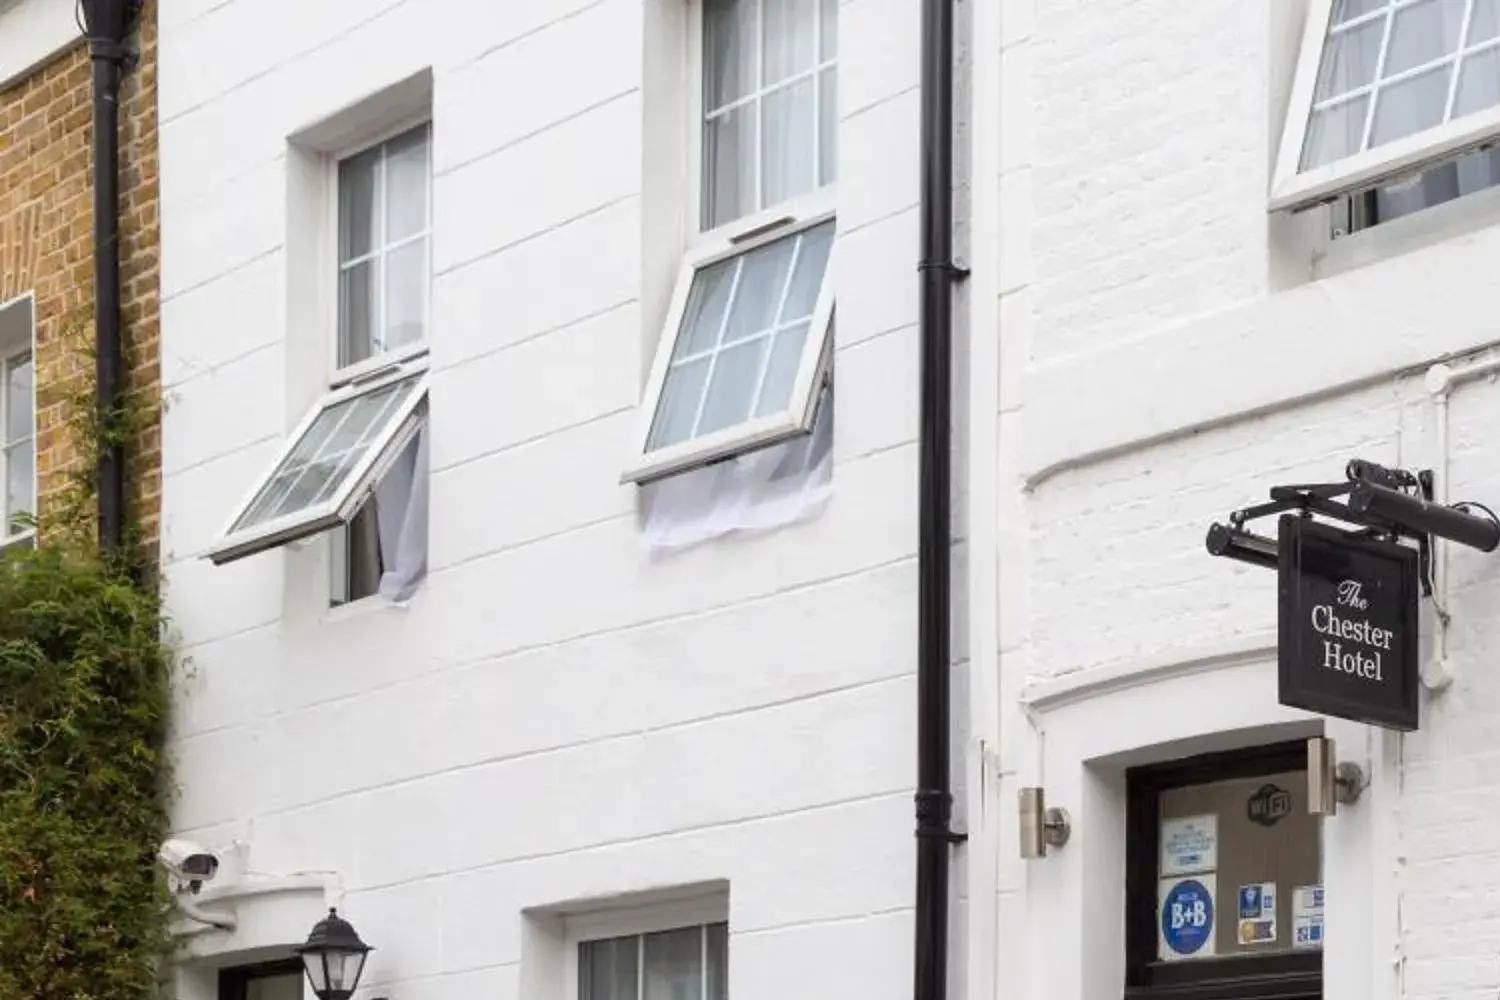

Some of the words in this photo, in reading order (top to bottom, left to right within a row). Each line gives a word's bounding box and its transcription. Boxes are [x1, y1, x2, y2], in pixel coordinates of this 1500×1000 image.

[1337, 579, 1368, 610] The
[1311, 605, 1393, 650] Chester
[1322, 641, 1382, 681] Hotel
[1171, 900, 1207, 929] B+B
